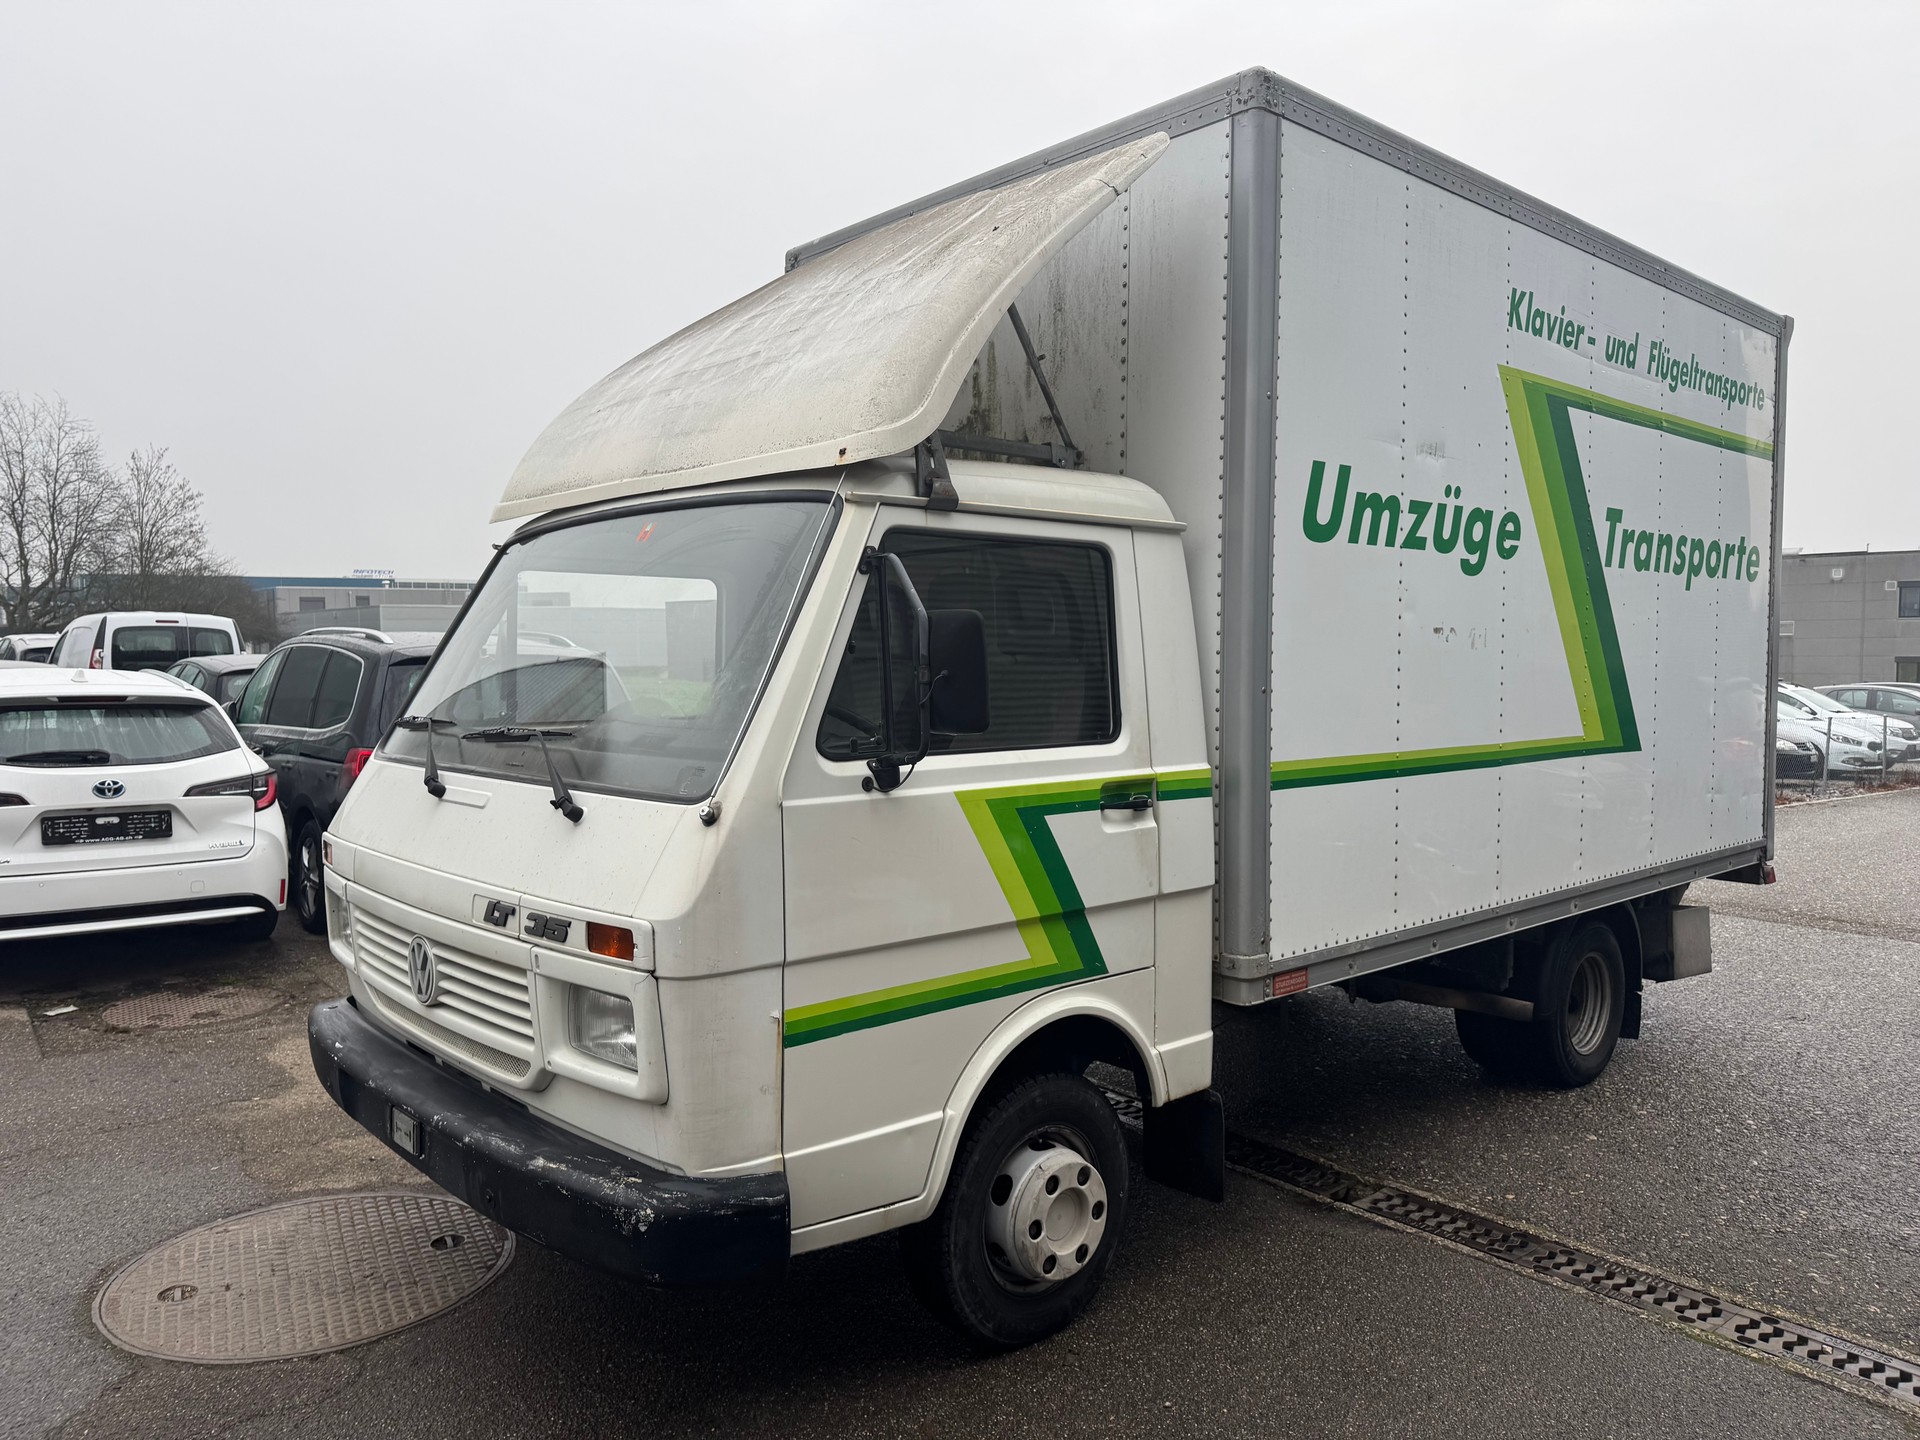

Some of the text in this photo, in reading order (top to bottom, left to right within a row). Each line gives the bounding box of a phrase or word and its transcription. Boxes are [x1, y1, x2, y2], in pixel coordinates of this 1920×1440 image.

[1605, 332, 1638, 370] und
[1647, 341, 1766, 412] Flügeltransporte
[1302, 460, 1521, 577] Umzüge
[1605, 507, 1760, 591] Transporte
[483, 899, 572, 943] LT 35
